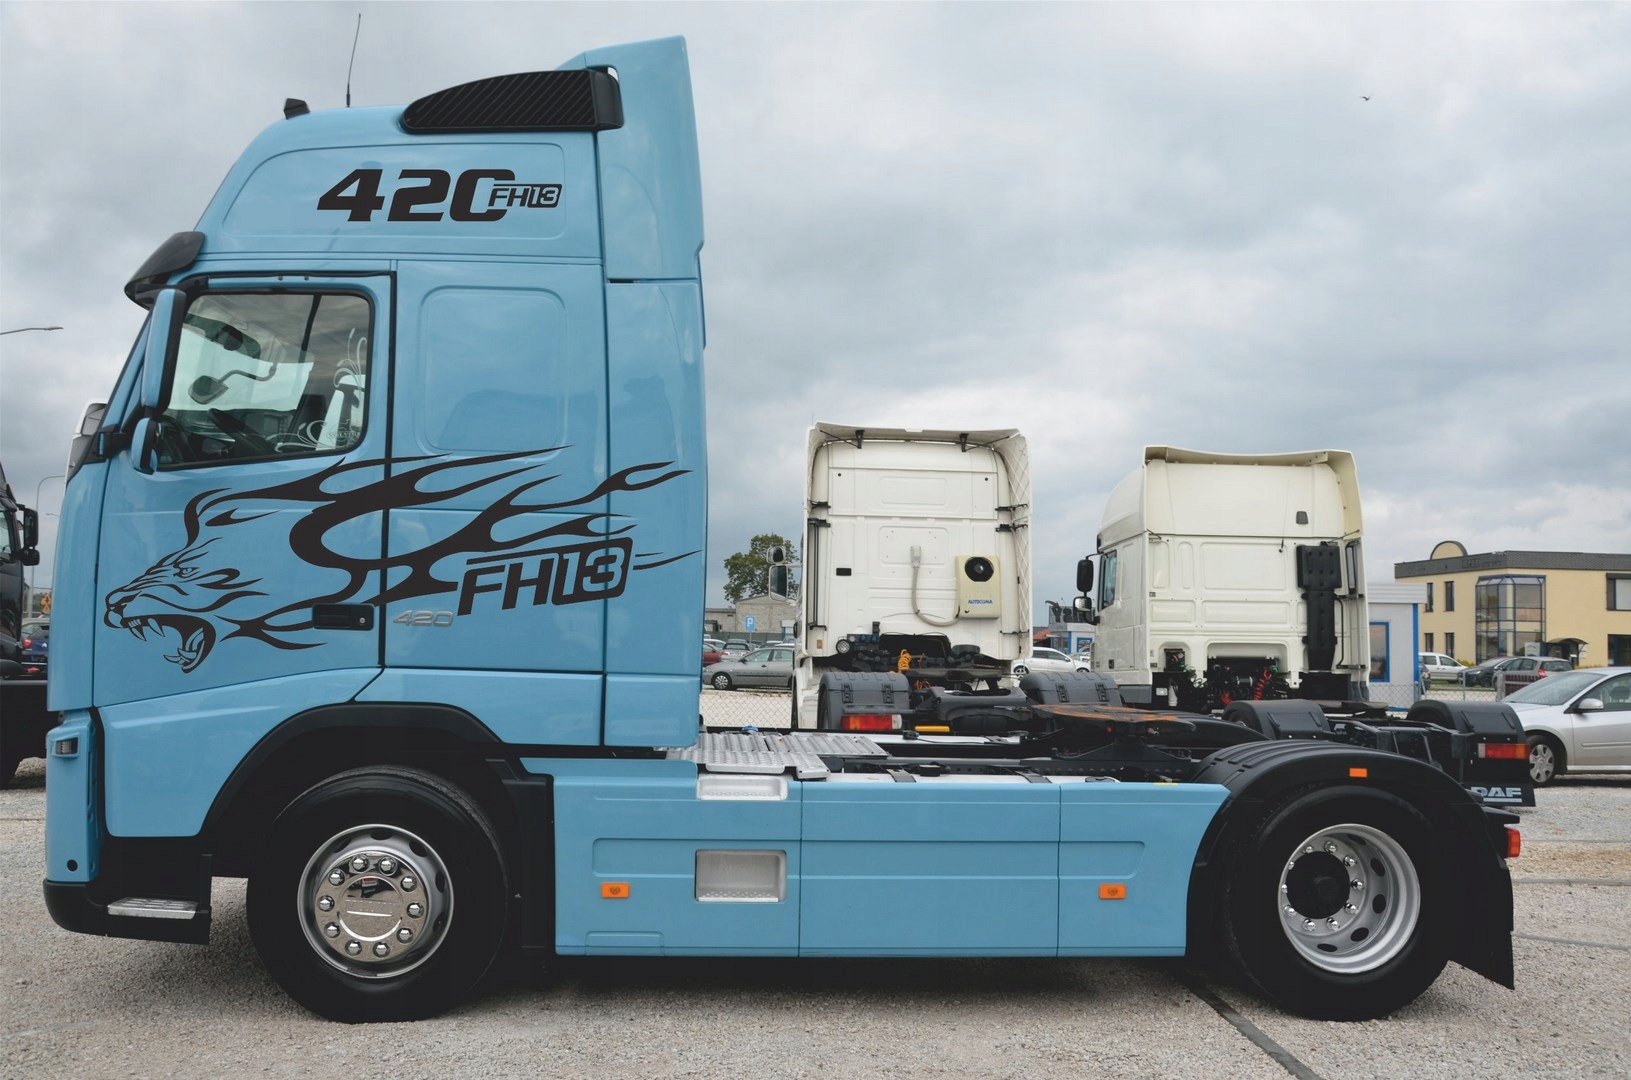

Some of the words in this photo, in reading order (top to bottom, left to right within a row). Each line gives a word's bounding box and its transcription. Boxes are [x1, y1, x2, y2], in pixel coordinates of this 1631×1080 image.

[488, 185, 562, 208] FH13
[457, 539, 631, 616] FH13
[393, 610, 454, 627] 420
[747, 617, 754, 627] P
[1471, 786, 1522, 798] DAF
